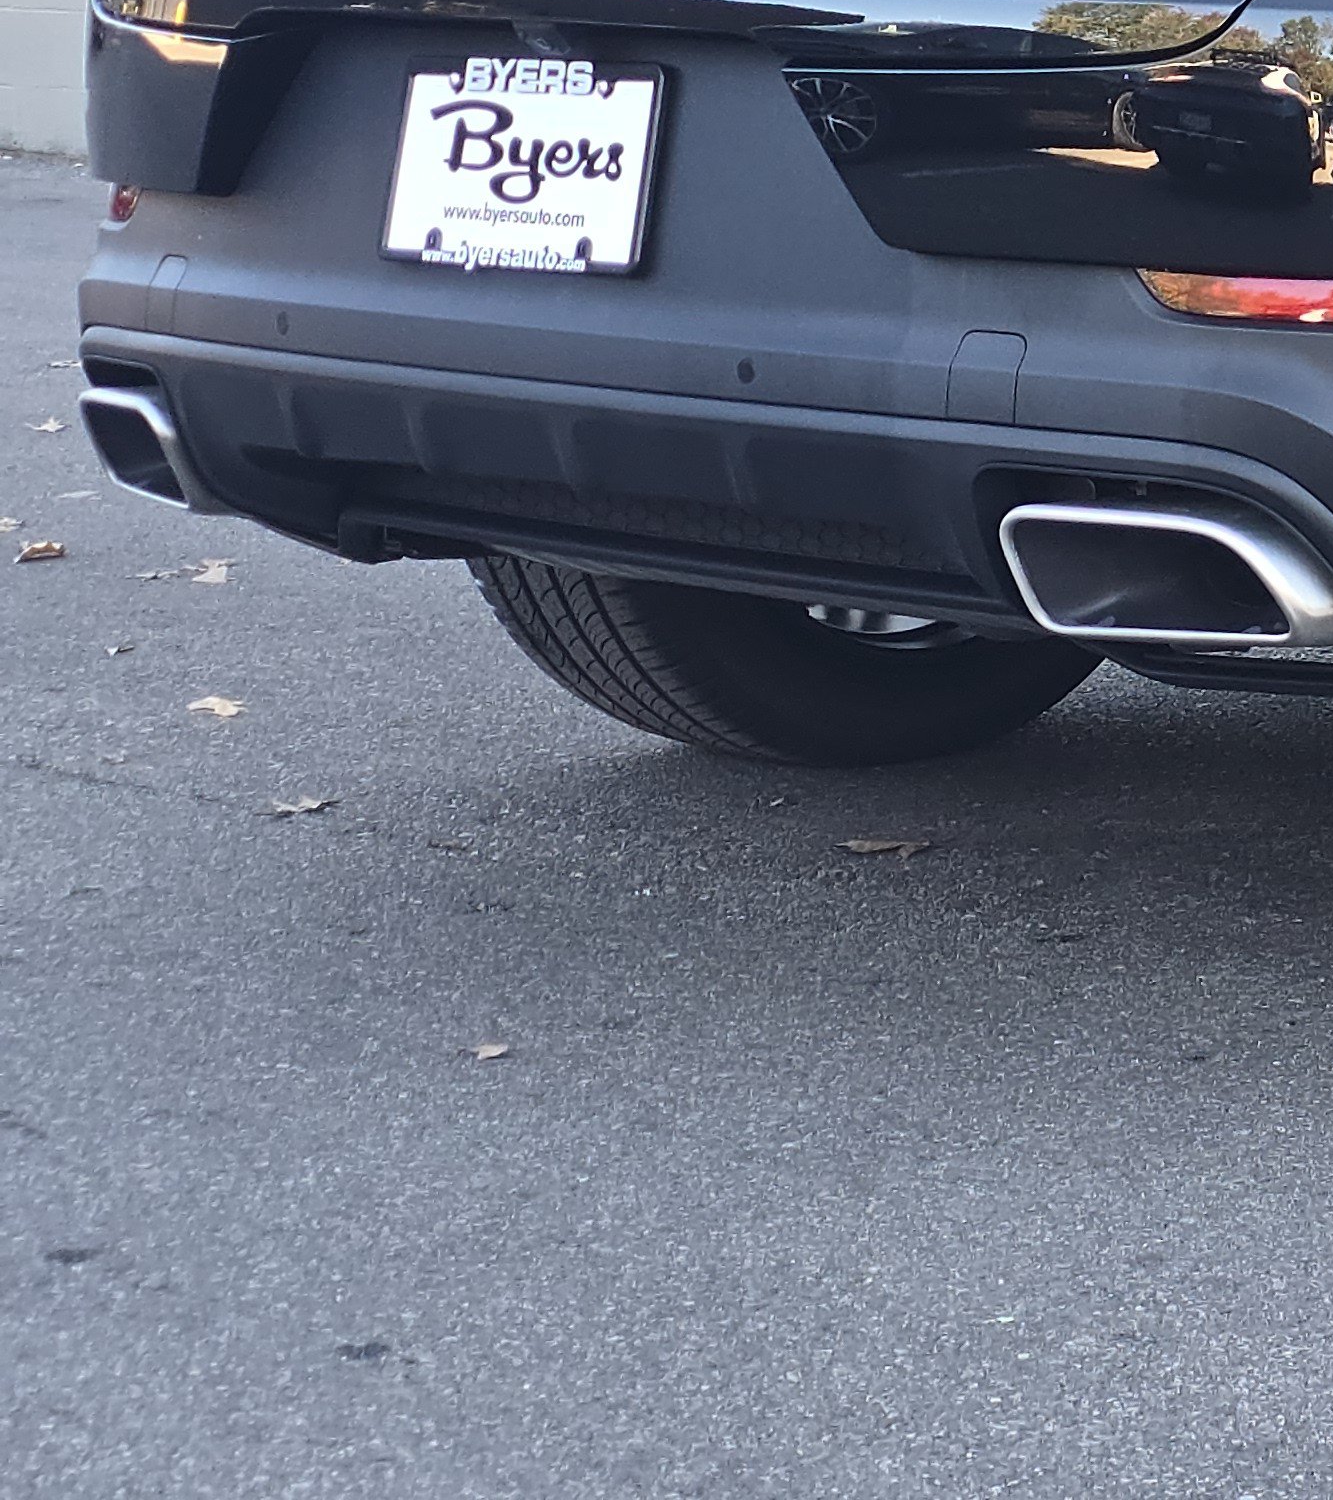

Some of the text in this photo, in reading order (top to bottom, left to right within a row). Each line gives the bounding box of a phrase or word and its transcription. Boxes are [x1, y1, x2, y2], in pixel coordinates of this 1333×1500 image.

[465, 57, 594, 96] BYERS
[432, 101, 624, 203] Byers
[444, 203, 585, 227] www.byersauto.com
[421, 240, 586, 273] www.byersauto.com
